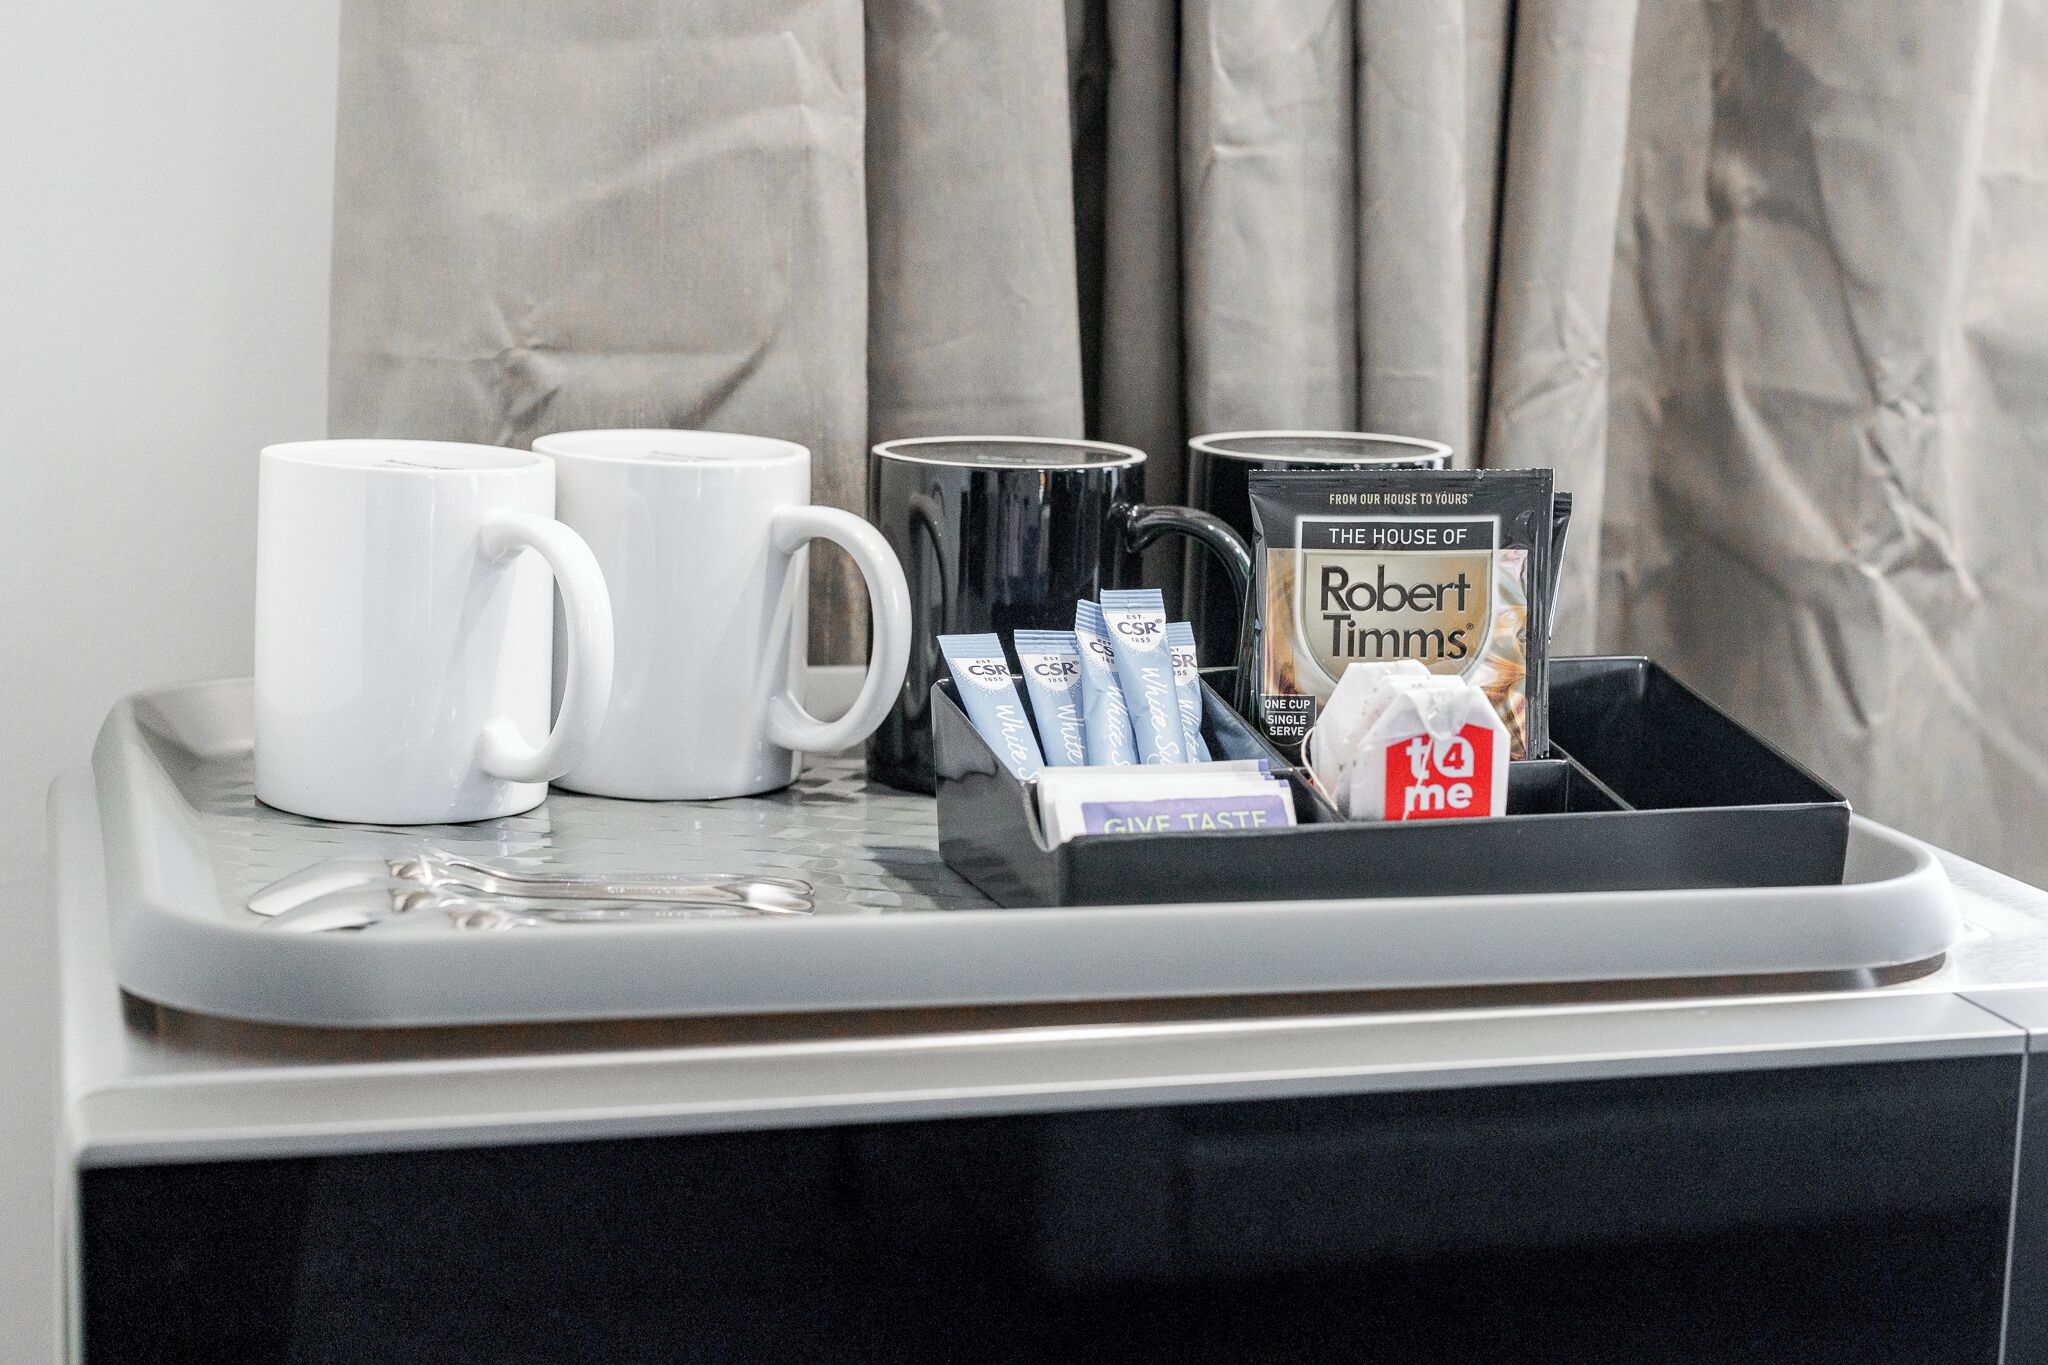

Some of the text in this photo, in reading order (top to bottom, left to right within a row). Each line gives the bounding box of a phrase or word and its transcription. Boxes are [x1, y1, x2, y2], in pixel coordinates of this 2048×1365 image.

[1329, 493, 1357, 505] FROM
[1360, 493, 1381, 505] OUR
[1384, 493, 1417, 505] HOUSE
[1420, 493, 1432, 505] TO
[1328, 528, 1468, 545] THE HOUSE OF
[1320, 564, 1471, 612] Robert
[1117, 621, 1161, 636] CSR
[1322, 612, 1468, 660] Timms
[1089, 641, 1115, 657] CS
[1033, 662, 1079, 676] CSR
[1171, 654, 1197, 668] SR
[967, 664, 1011, 676] CSR
[1141, 667, 1169, 732] White
[1264, 699, 1311, 709] ONE CUP
[1106, 685, 1129, 748] White
[1267, 714, 1307, 725] SINGLE
[995, 703, 1029, 765] White
[1056, 703, 1086, 765] White
[1269, 726, 1305, 736] SERVE
[1404, 782, 1473, 811] me
[1103, 809, 1267, 835] GIVE TASTE
